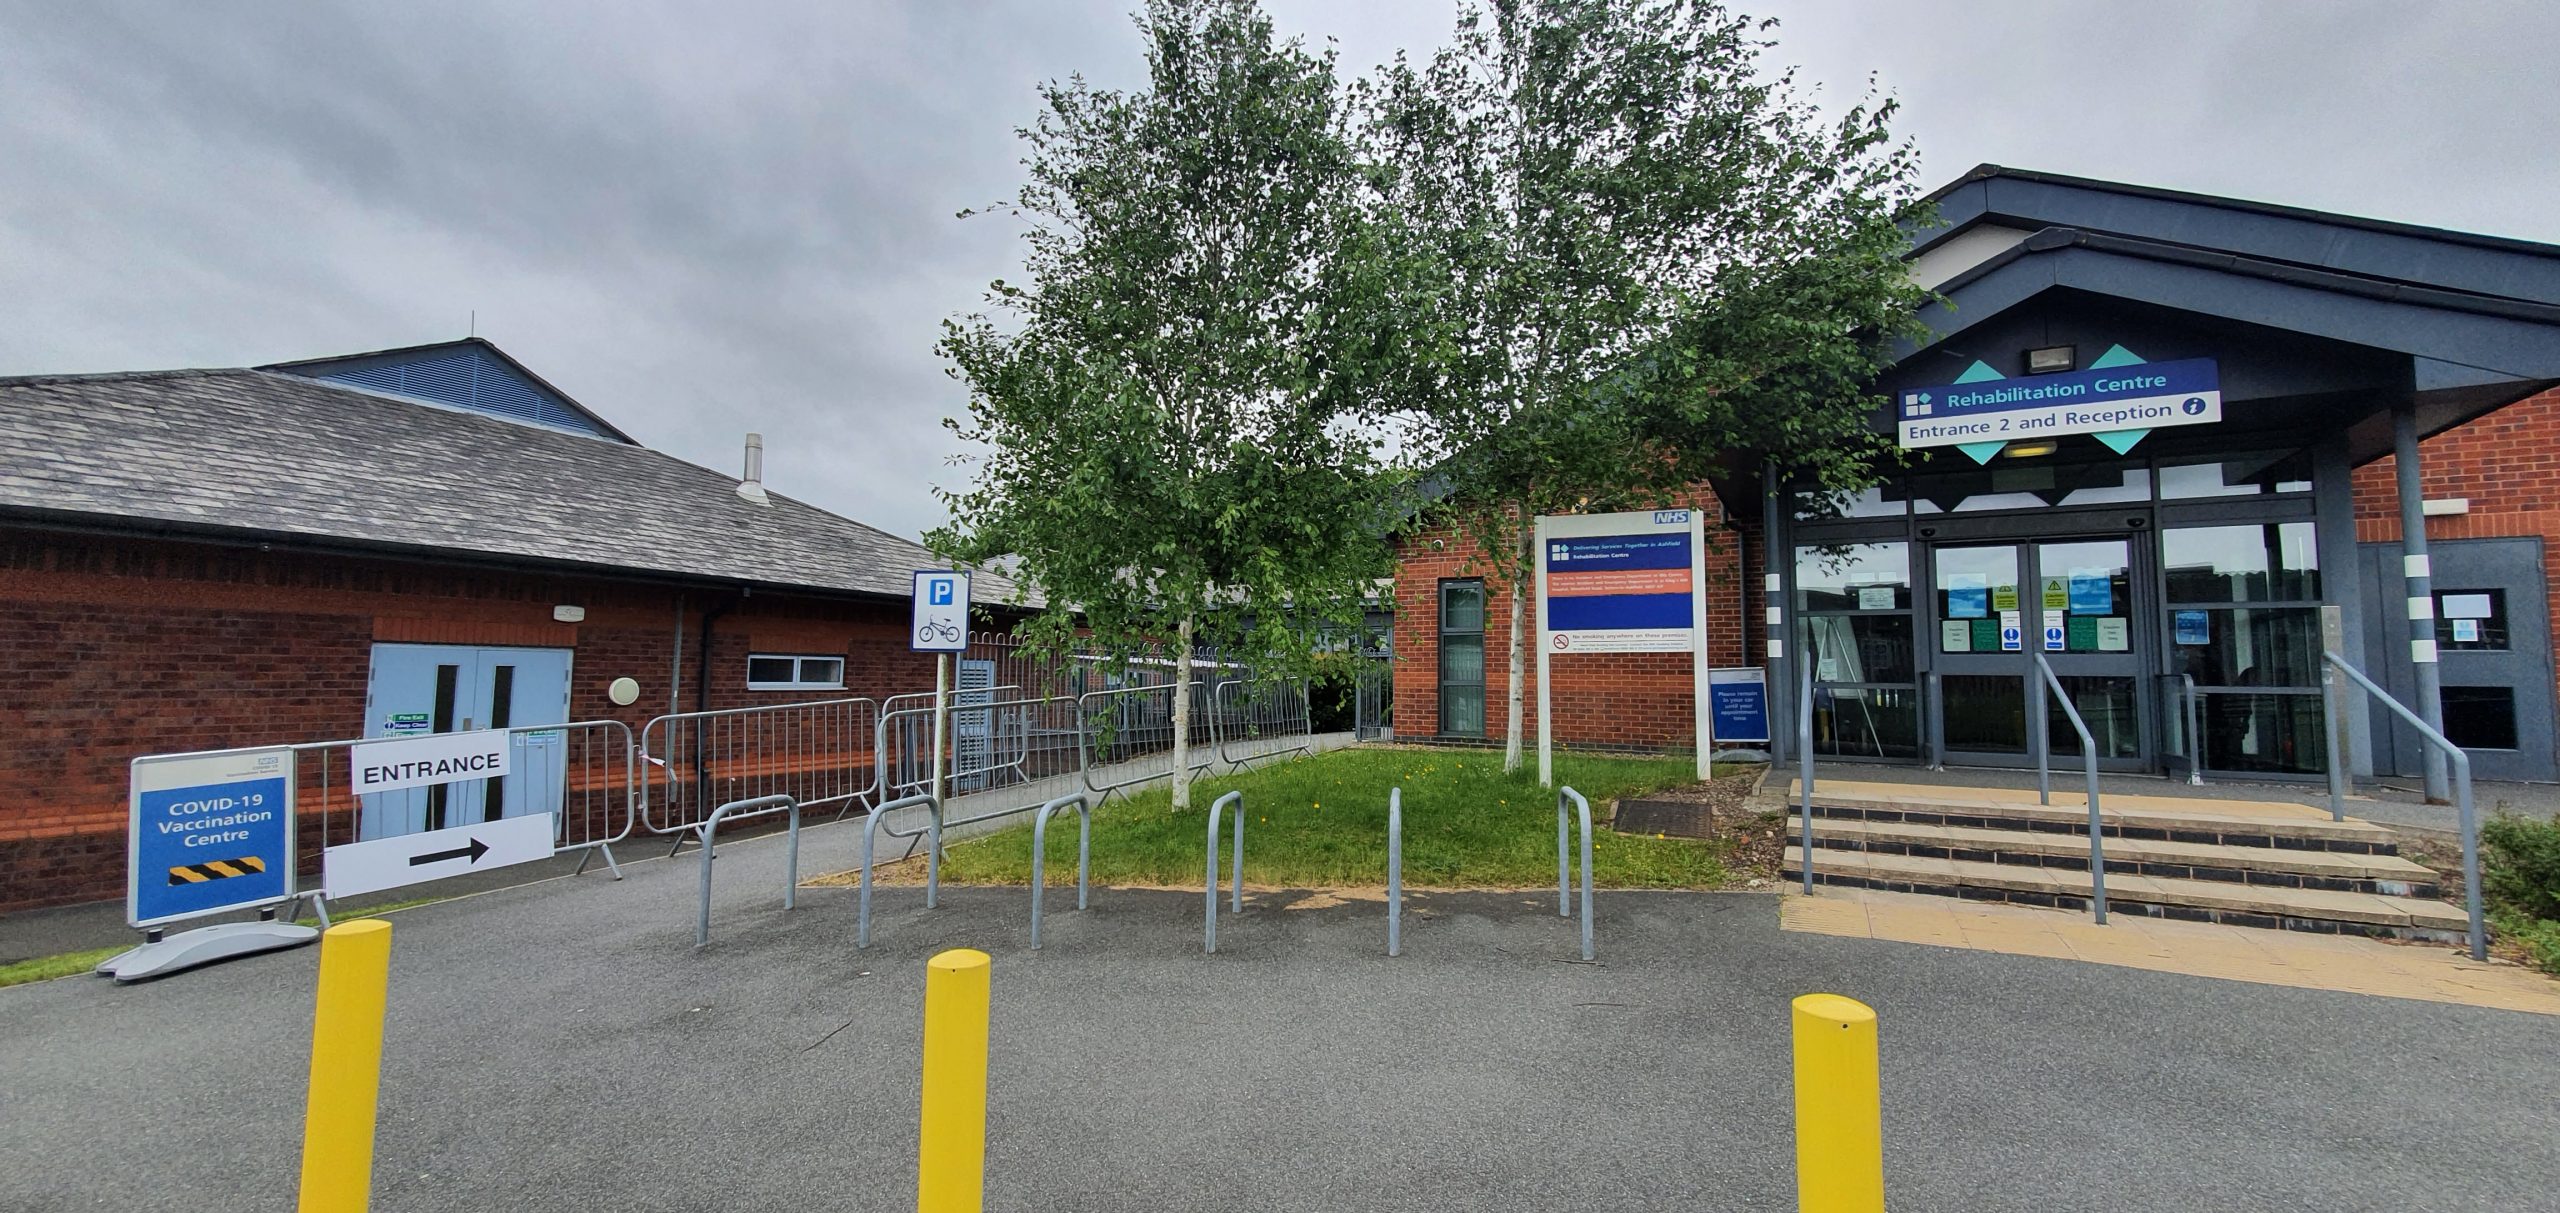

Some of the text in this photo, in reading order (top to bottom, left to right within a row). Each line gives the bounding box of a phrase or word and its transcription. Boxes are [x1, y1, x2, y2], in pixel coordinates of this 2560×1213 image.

[1948, 375, 2167, 407] Rehabilitation Centre
[1910, 404, 2172, 439] Entrance 2 and Reception
[1655, 512, 1687, 523] NHS
[935, 582, 951, 603] P
[364, 753, 500, 784] ENTRANCE
[169, 794, 263, 816] COVID-19
[158, 811, 272, 834] Vaccination
[184, 831, 249, 848] Centre
